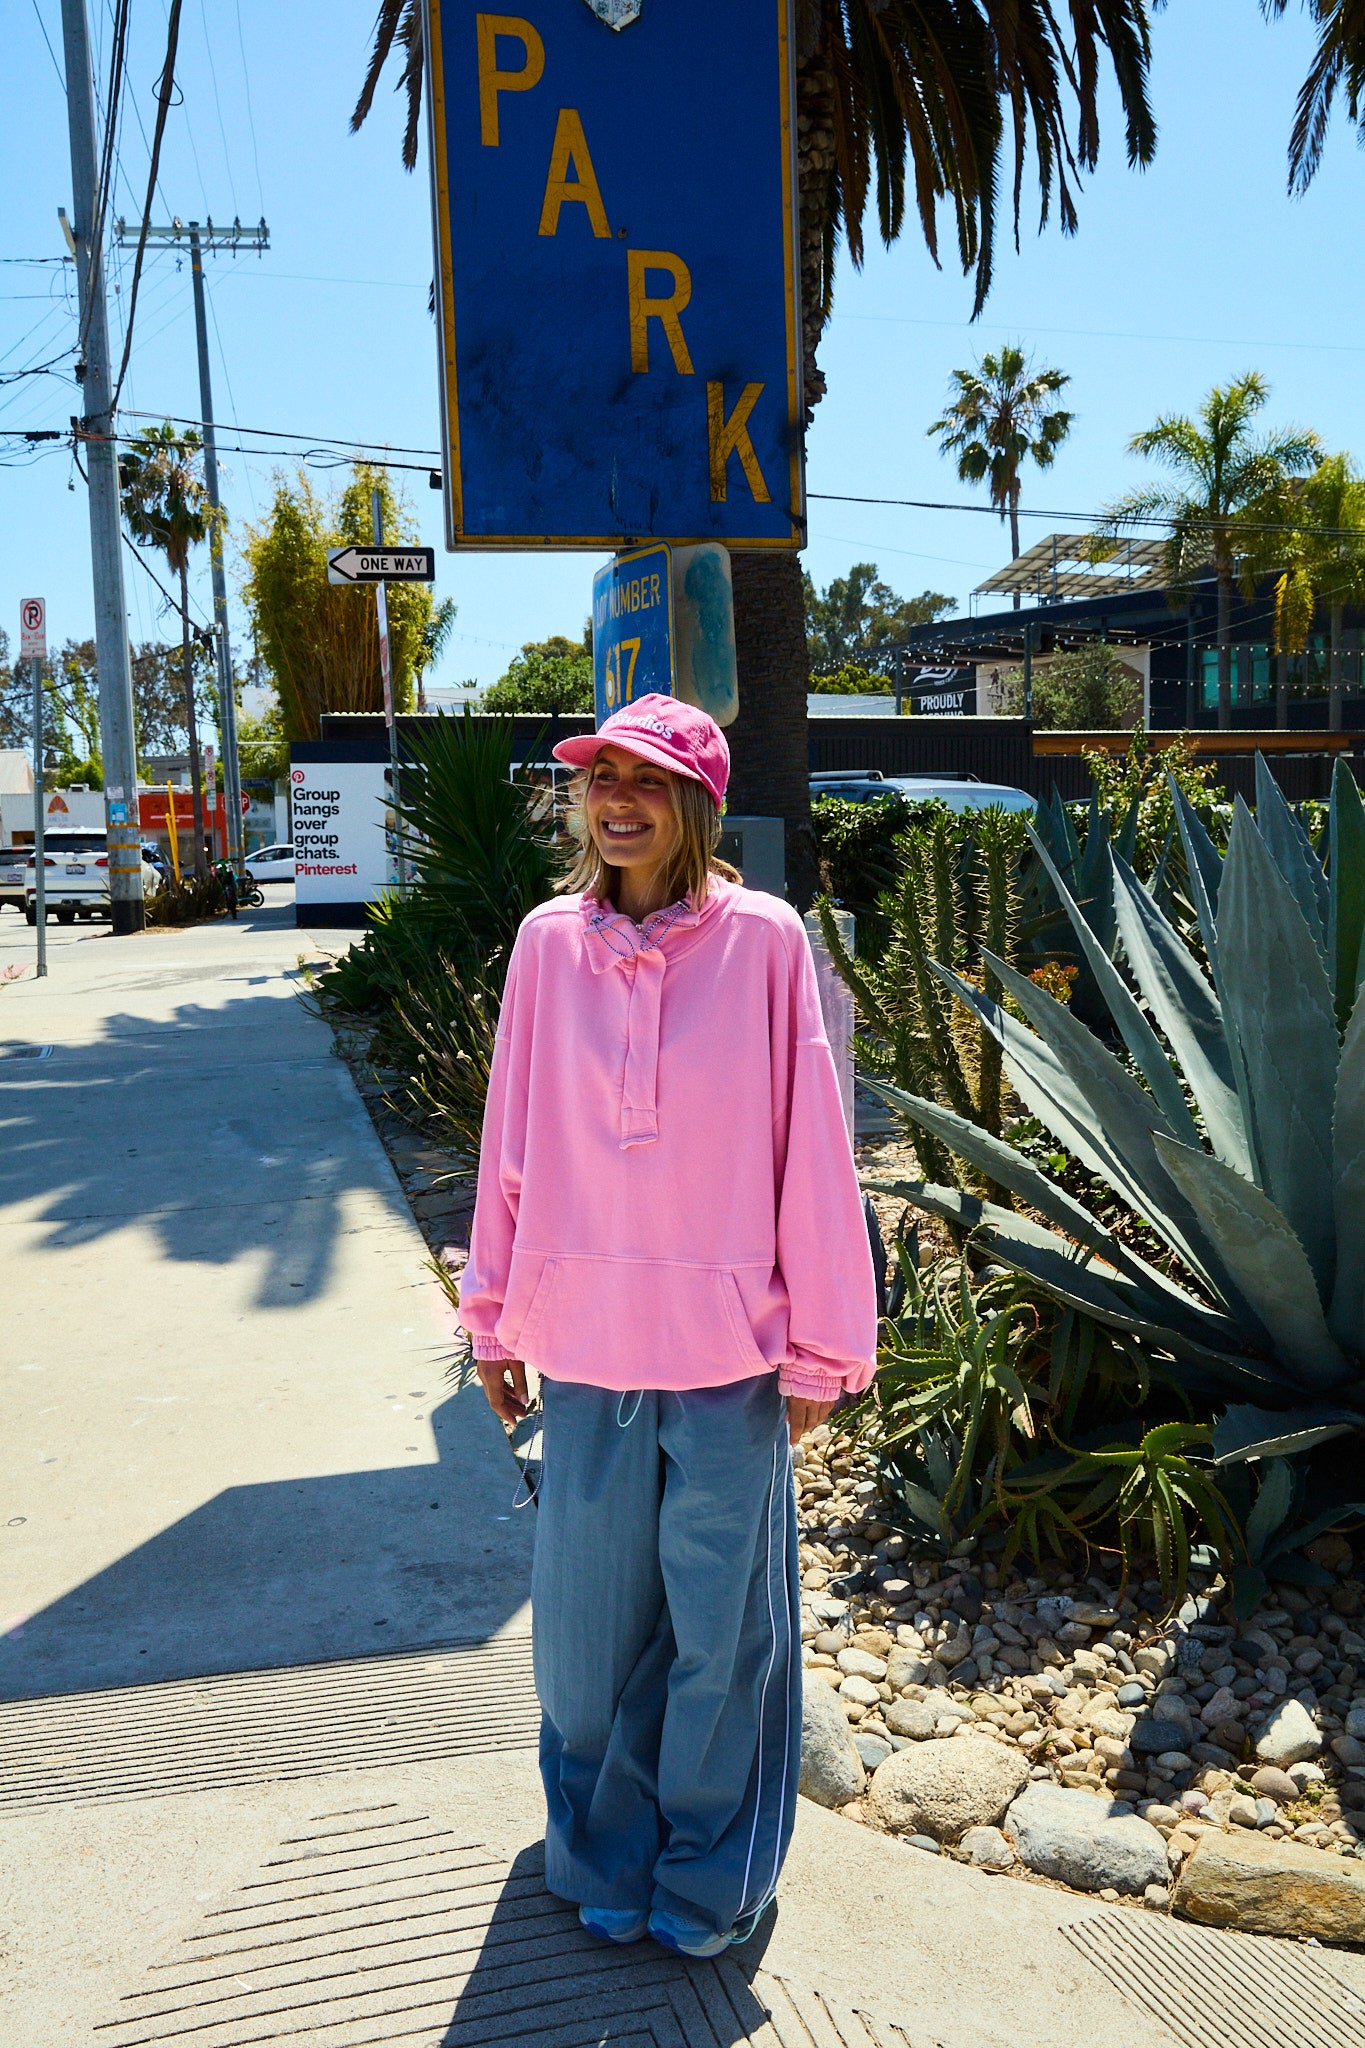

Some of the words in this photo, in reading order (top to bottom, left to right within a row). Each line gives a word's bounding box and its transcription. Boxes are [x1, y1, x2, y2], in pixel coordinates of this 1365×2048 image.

[476, 13, 771, 503] PARK
[360, 558, 389, 571] ONE
[394, 558, 423, 571] WAY
[596, 593, 608, 628] LOT
[609, 573, 660, 620] NUMBER
[605, 637, 641, 708] 617
[920, 693, 964, 711] PROUDLY
[293, 787, 340, 802] Group
[294, 803, 340, 818] hangs
[294, 820, 327, 830] over
[294, 834, 339, 847] group
[295, 847, 340, 859] chats.
[295, 863, 358, 876] Pinterest
